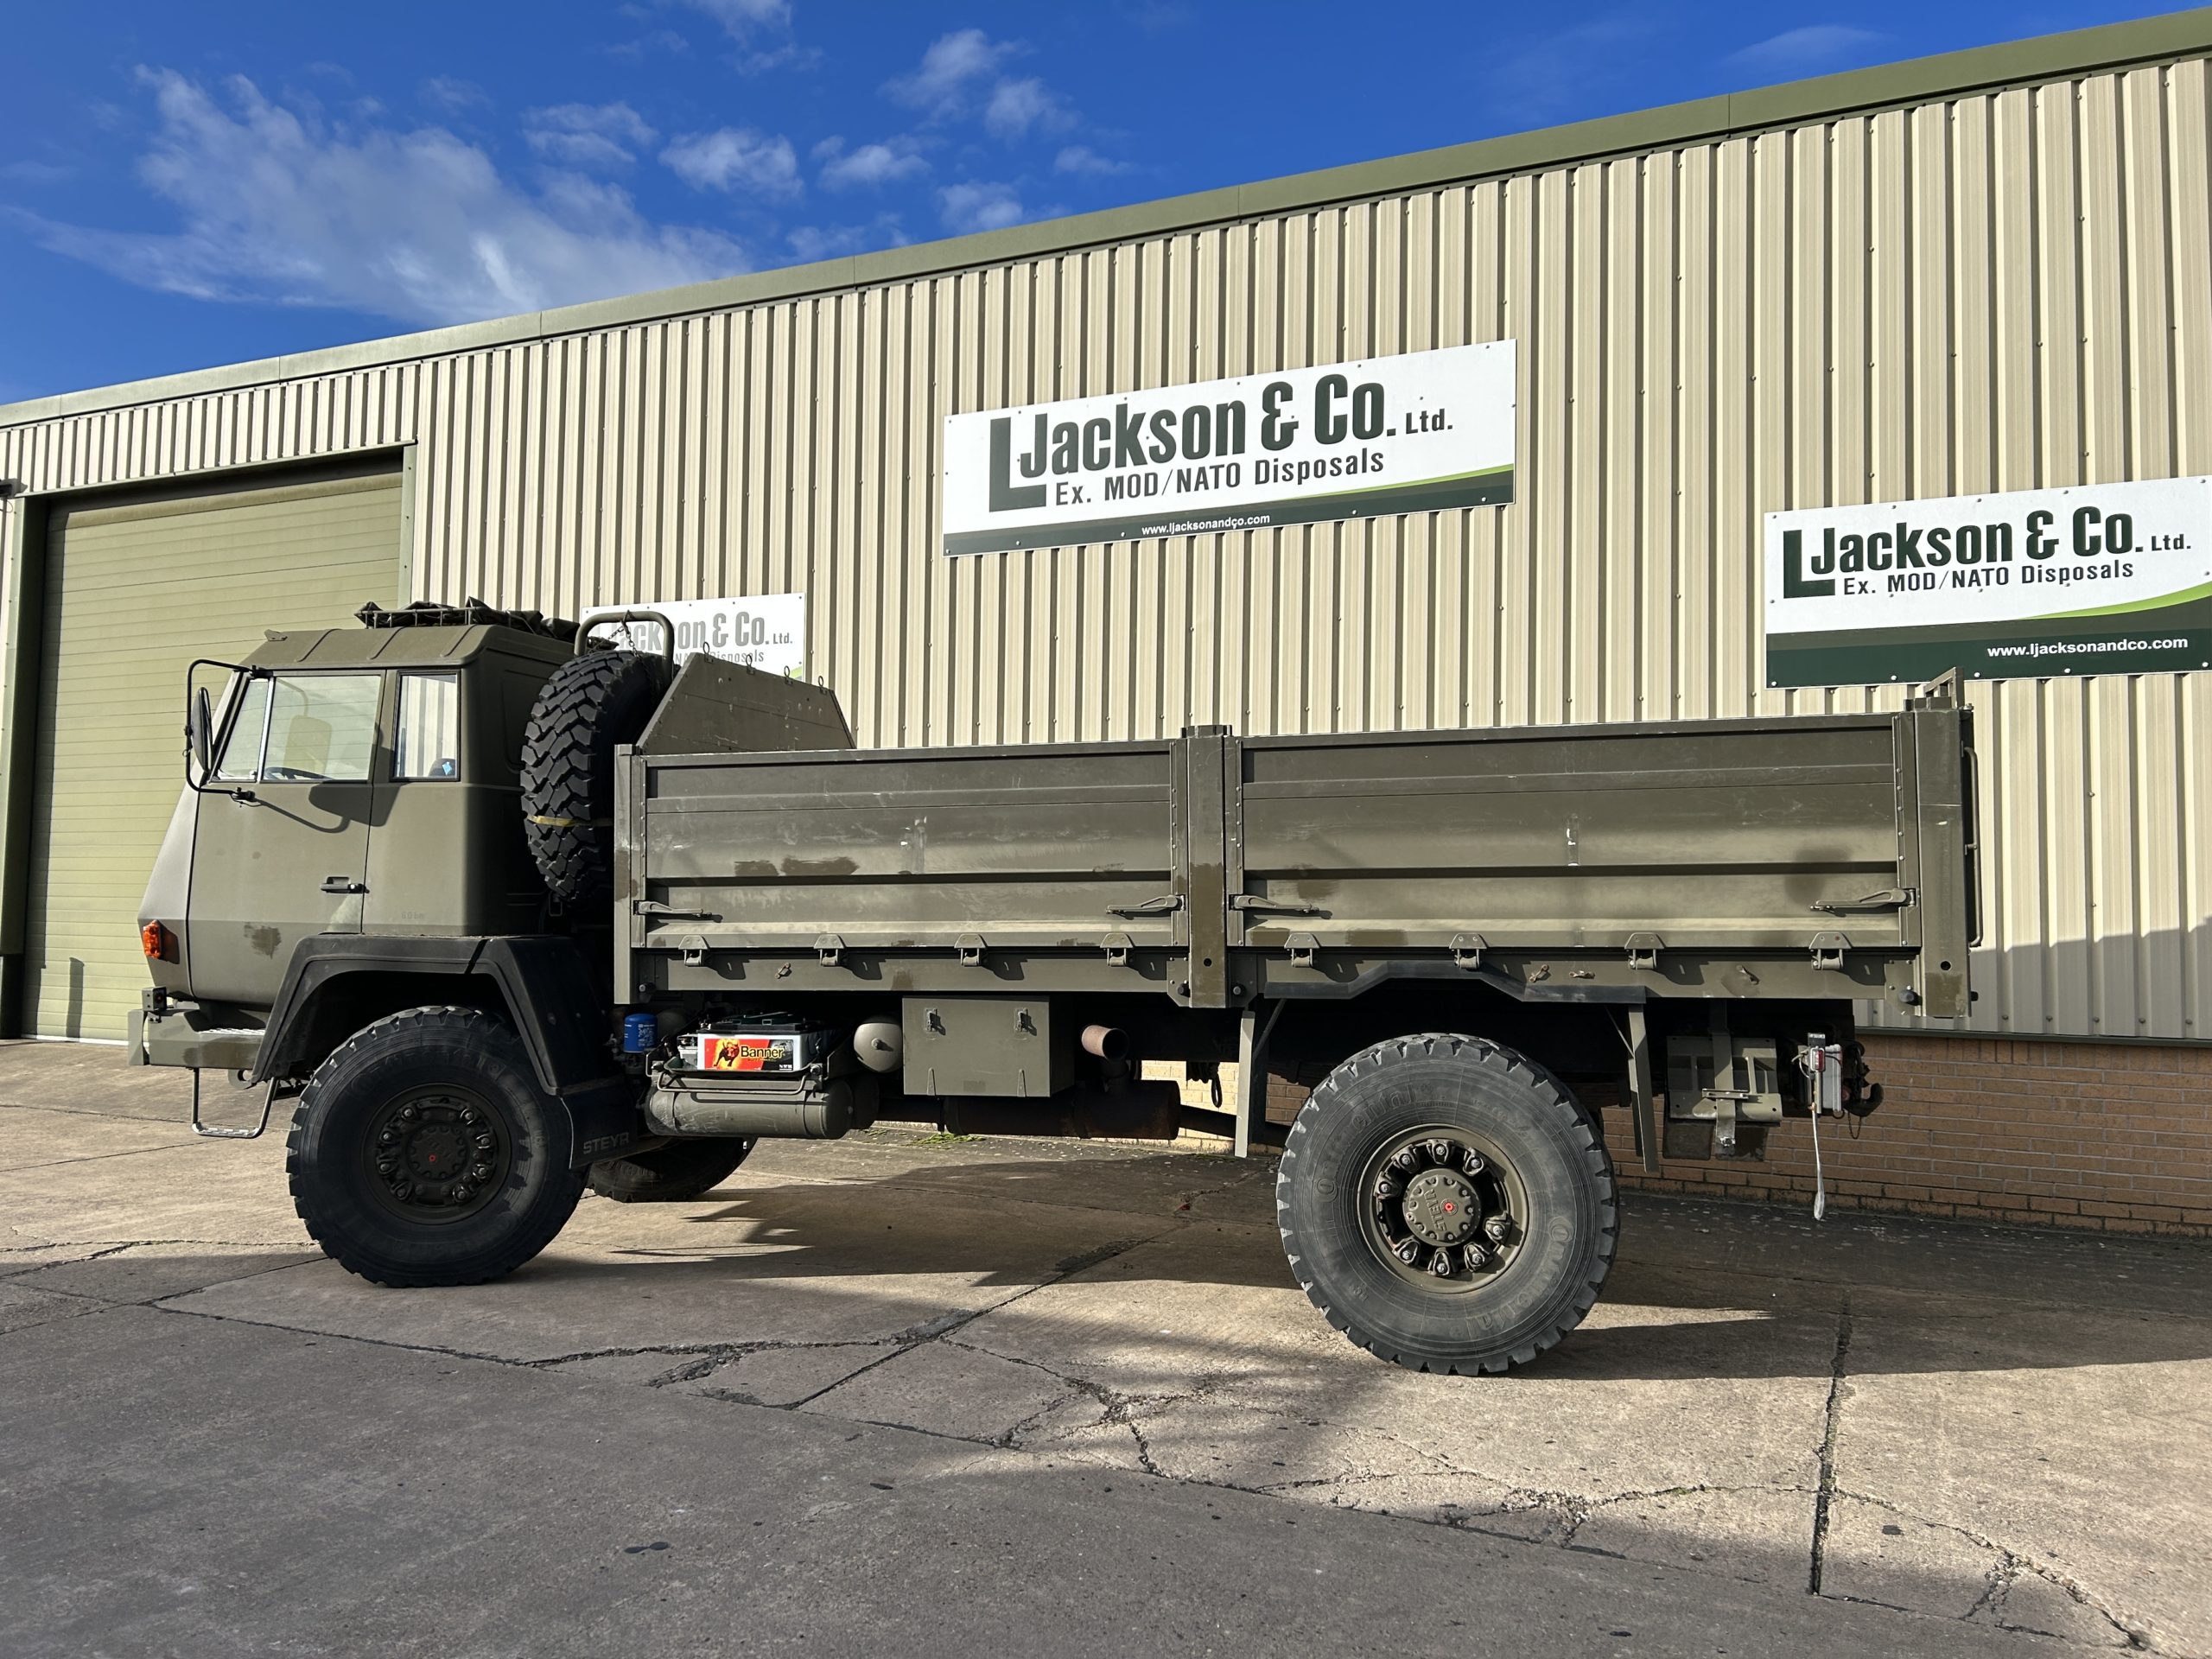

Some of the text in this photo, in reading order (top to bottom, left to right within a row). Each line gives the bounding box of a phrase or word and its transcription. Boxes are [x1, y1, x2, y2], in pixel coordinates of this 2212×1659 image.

[1262, 381, 1300, 451] &
[1314, 373, 1396, 445] Co.
[1406, 408, 1453, 435] Ltd.
[1056, 448, 1384, 505] Ex. MOD/NATO Disposals
[1141, 514, 1270, 536] www.ljacksonandco.com
[2026, 510, 2059, 560] &
[2072, 505, 2144, 557] Co.
[2152, 533, 2191, 551] Ltd.
[1844, 559, 2133, 595] Ex. MOD/NATO Disposals
[712, 613, 728, 647] &
[734, 611, 769, 647] Co.
[772, 632, 792, 645] Ltd.
[1987, 638, 2189, 658] www.ljacksonandco.com
[741, 1046, 784, 1058] Banner
[583, 1132, 629, 1154] STEYR
[1424, 1189, 1447, 1231] STEYR
